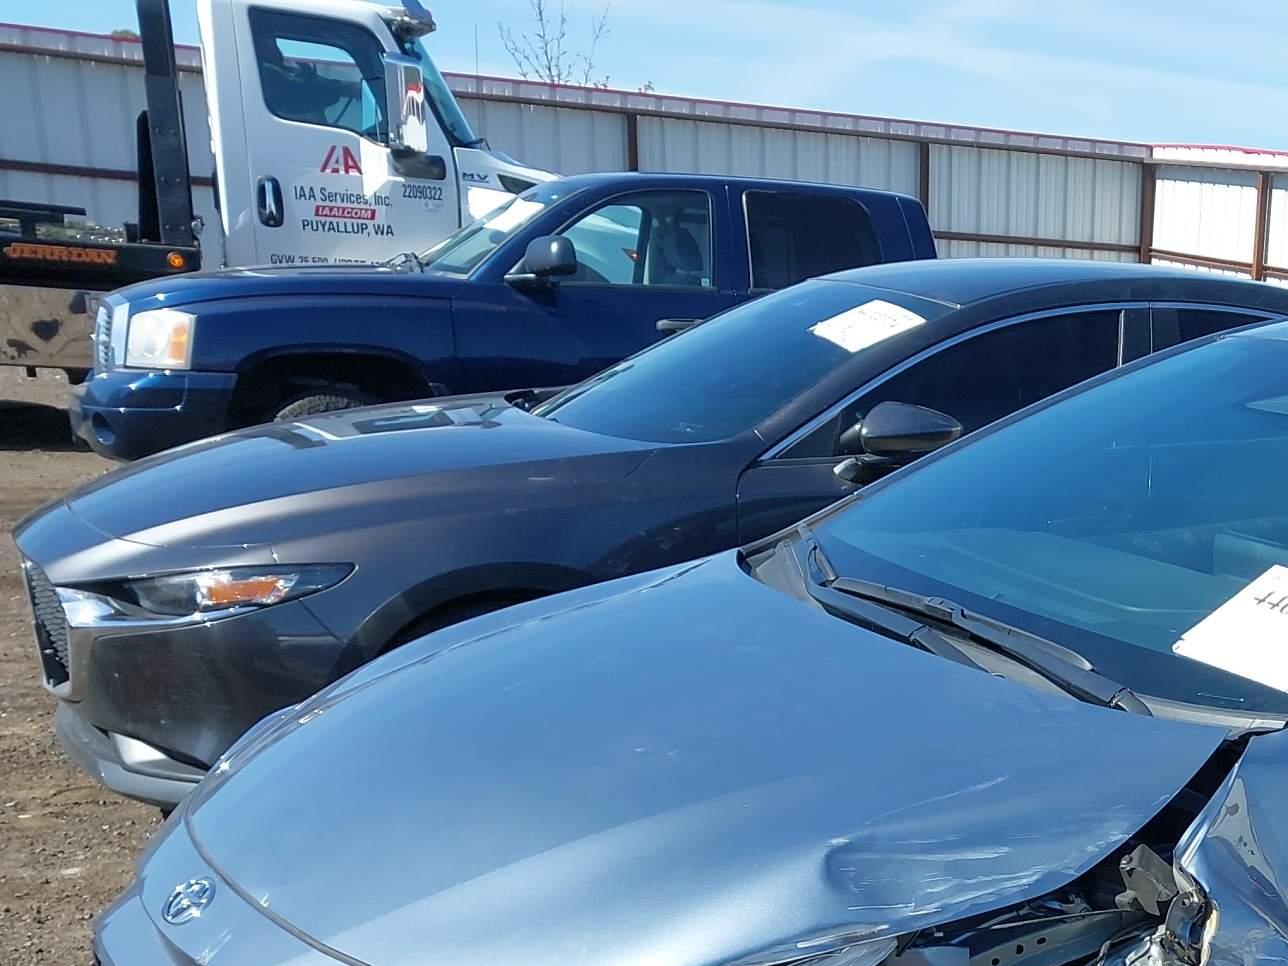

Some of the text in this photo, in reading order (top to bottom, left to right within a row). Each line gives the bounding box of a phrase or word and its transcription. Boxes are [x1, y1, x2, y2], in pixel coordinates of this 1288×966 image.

[294, 185, 393, 207] IAA Services, Inc.
[318, 206, 372, 219] IAAI.COM
[302, 219, 394, 237] PUYALLUP, WA
[270, 253, 295, 265] GVW
